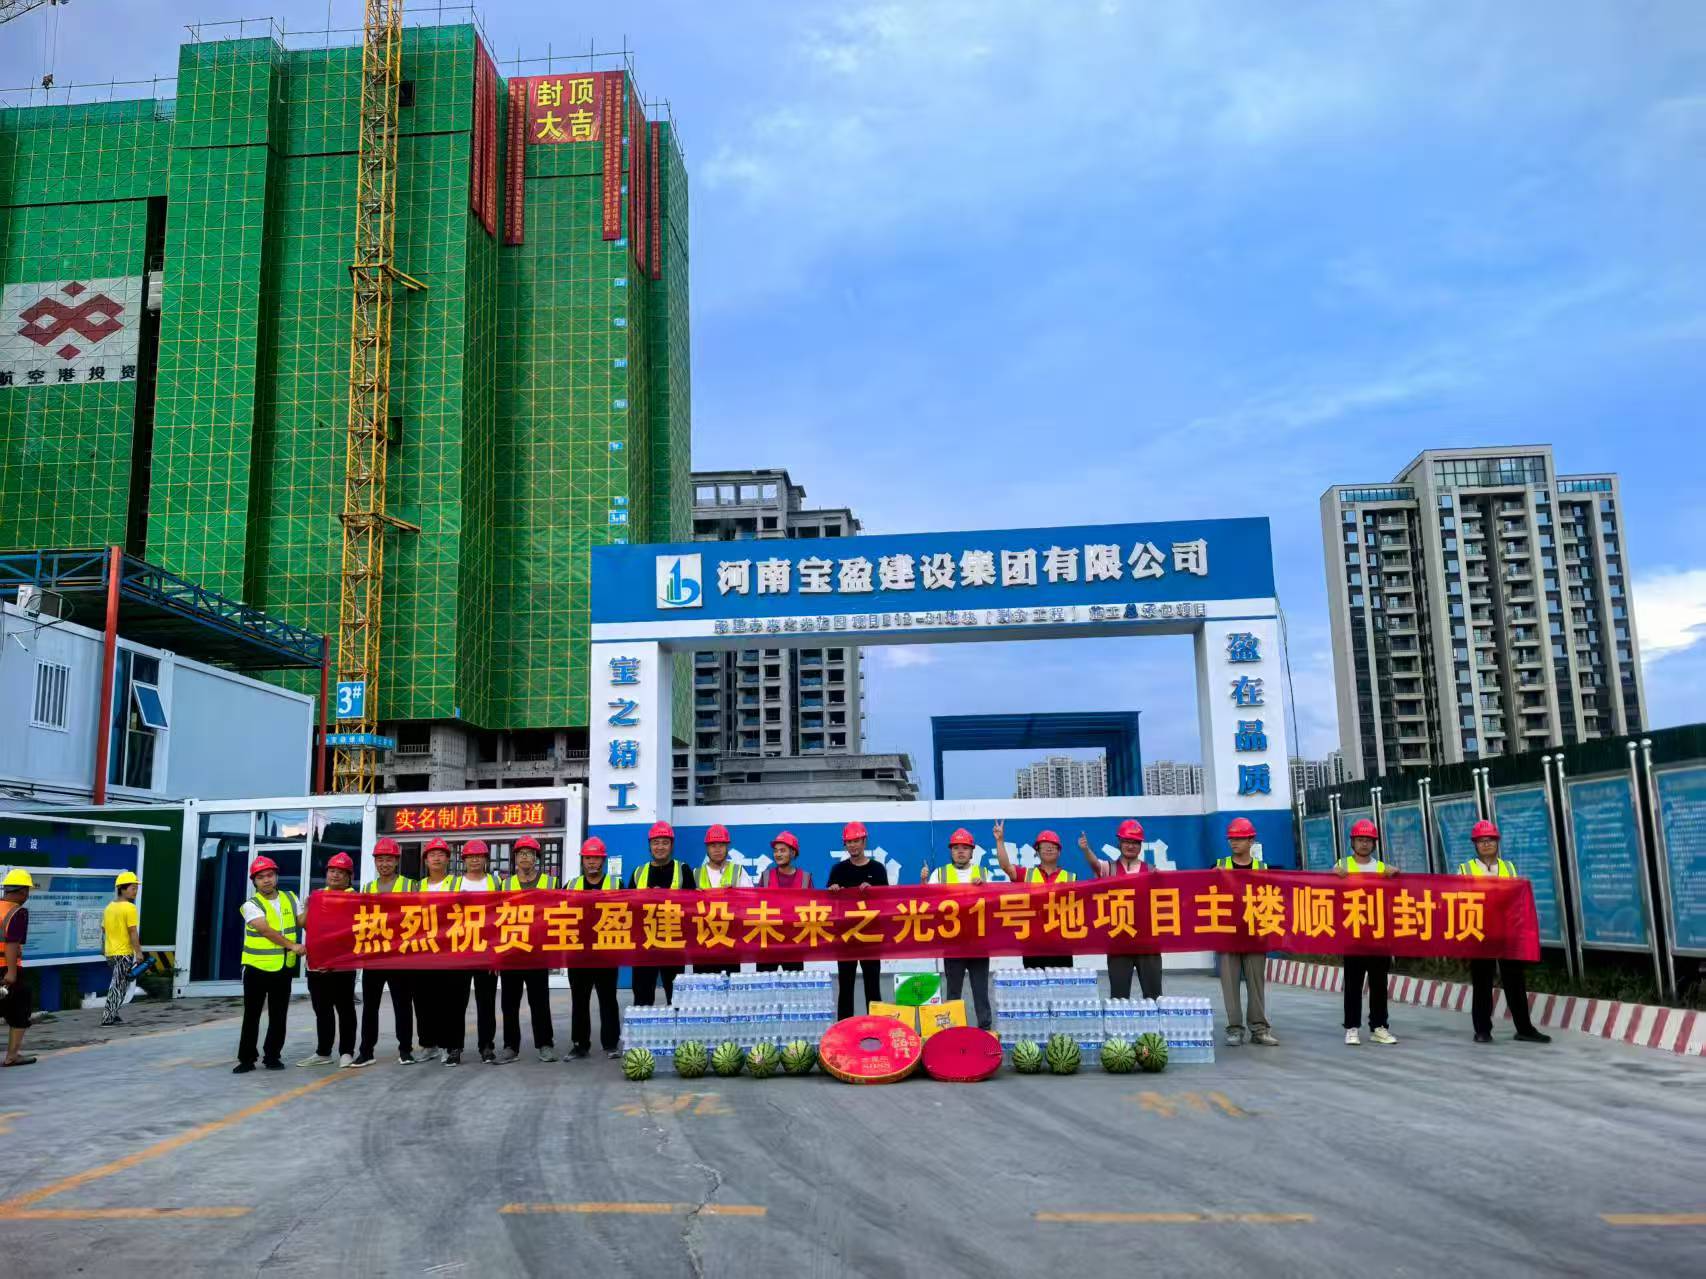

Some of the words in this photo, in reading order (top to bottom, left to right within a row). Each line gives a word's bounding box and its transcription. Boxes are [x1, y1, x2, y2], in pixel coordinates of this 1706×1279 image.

[537, 78, 594, 106] 封顶
[536, 109, 594, 139] 大吉
[716, 537, 1208, 596] 河南宝盈建设集团有限公司
[338, 685, 362, 714] 3#
[1226, 632, 1272, 796] 盈在品质
[606, 655, 641, 812] 宝之精工
[396, 802, 545, 832] 实名制员工通道
[352, 884, 1486, 954] 热烈祝贺宝盈建设未来之光31号地项目主楼顺利封顶
